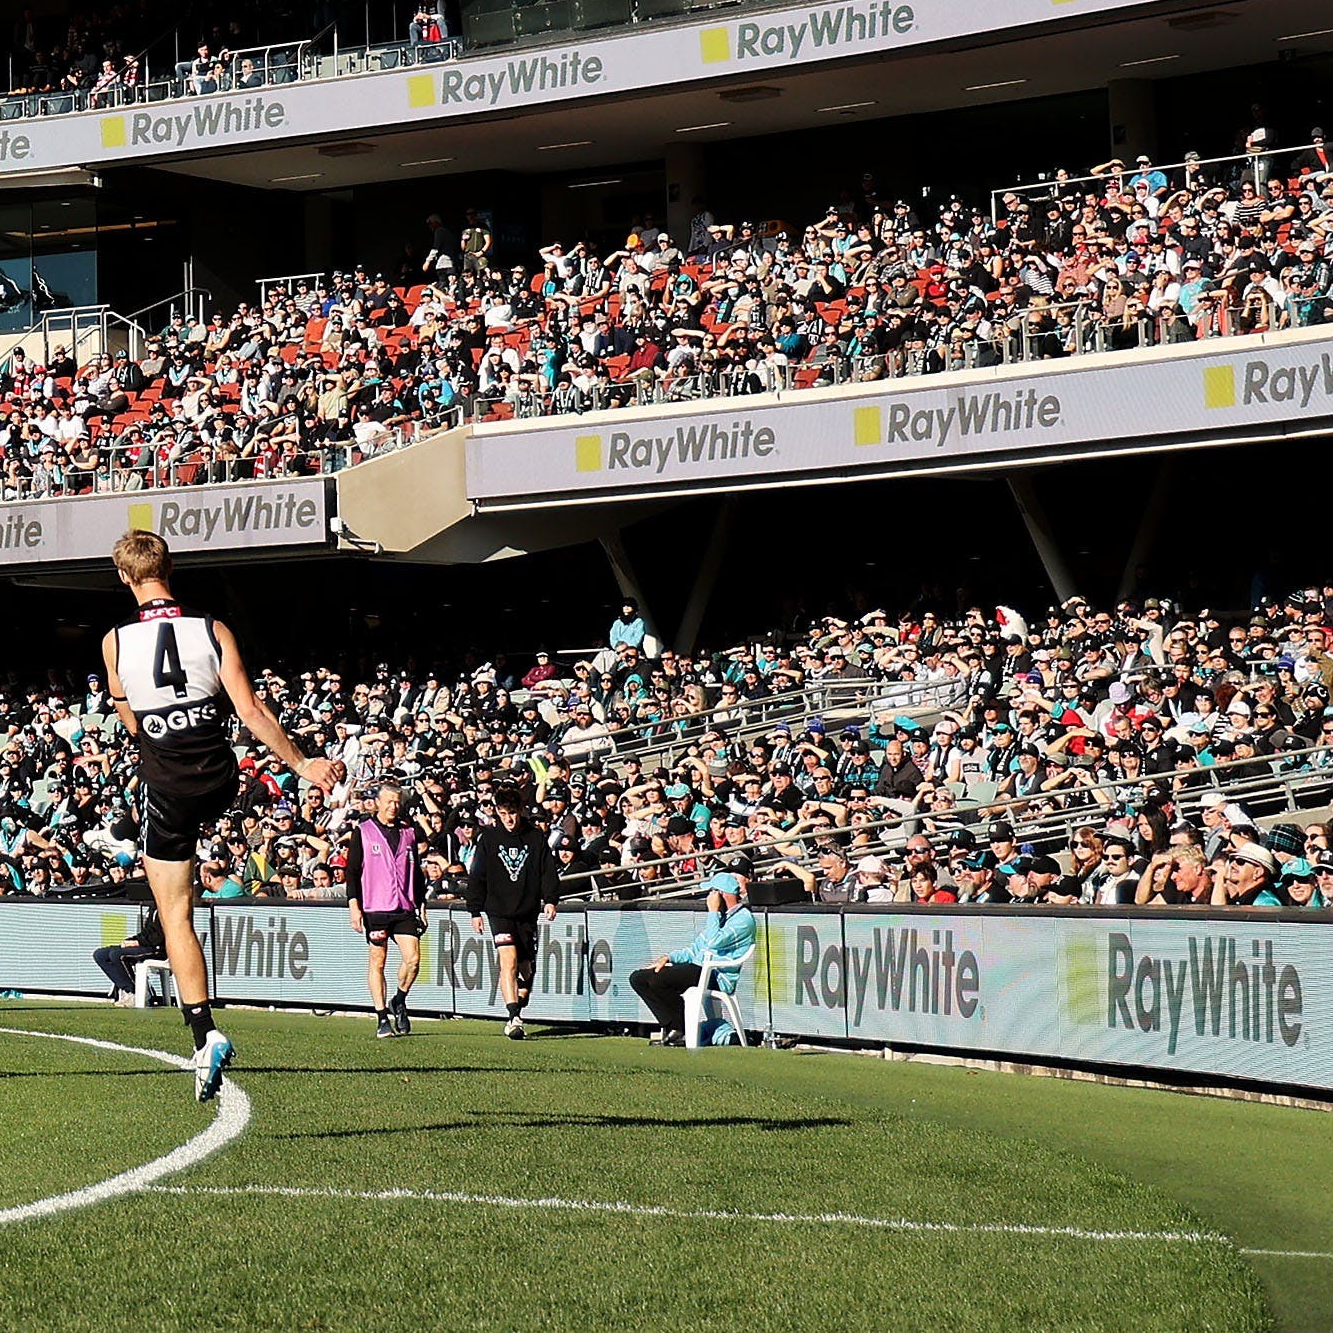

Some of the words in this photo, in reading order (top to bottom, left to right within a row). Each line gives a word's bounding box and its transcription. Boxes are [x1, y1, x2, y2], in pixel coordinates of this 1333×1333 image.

[736, 2, 916, 60] RayWhite
[442, 52, 603, 105] RayWhite
[131, 97, 286, 146] RayWhite
[886, 391, 1062, 446] RayWhite
[608, 422, 777, 473] RayWhite
[159, 496, 317, 545] RayWhite
[144, 607, 177, 619] KFC
[153, 622, 188, 698] 4
[436, 919, 613, 1007] Rayhite
[796, 925, 981, 1027] RayWhite
[1107, 932, 1303, 1056] RayWhite
